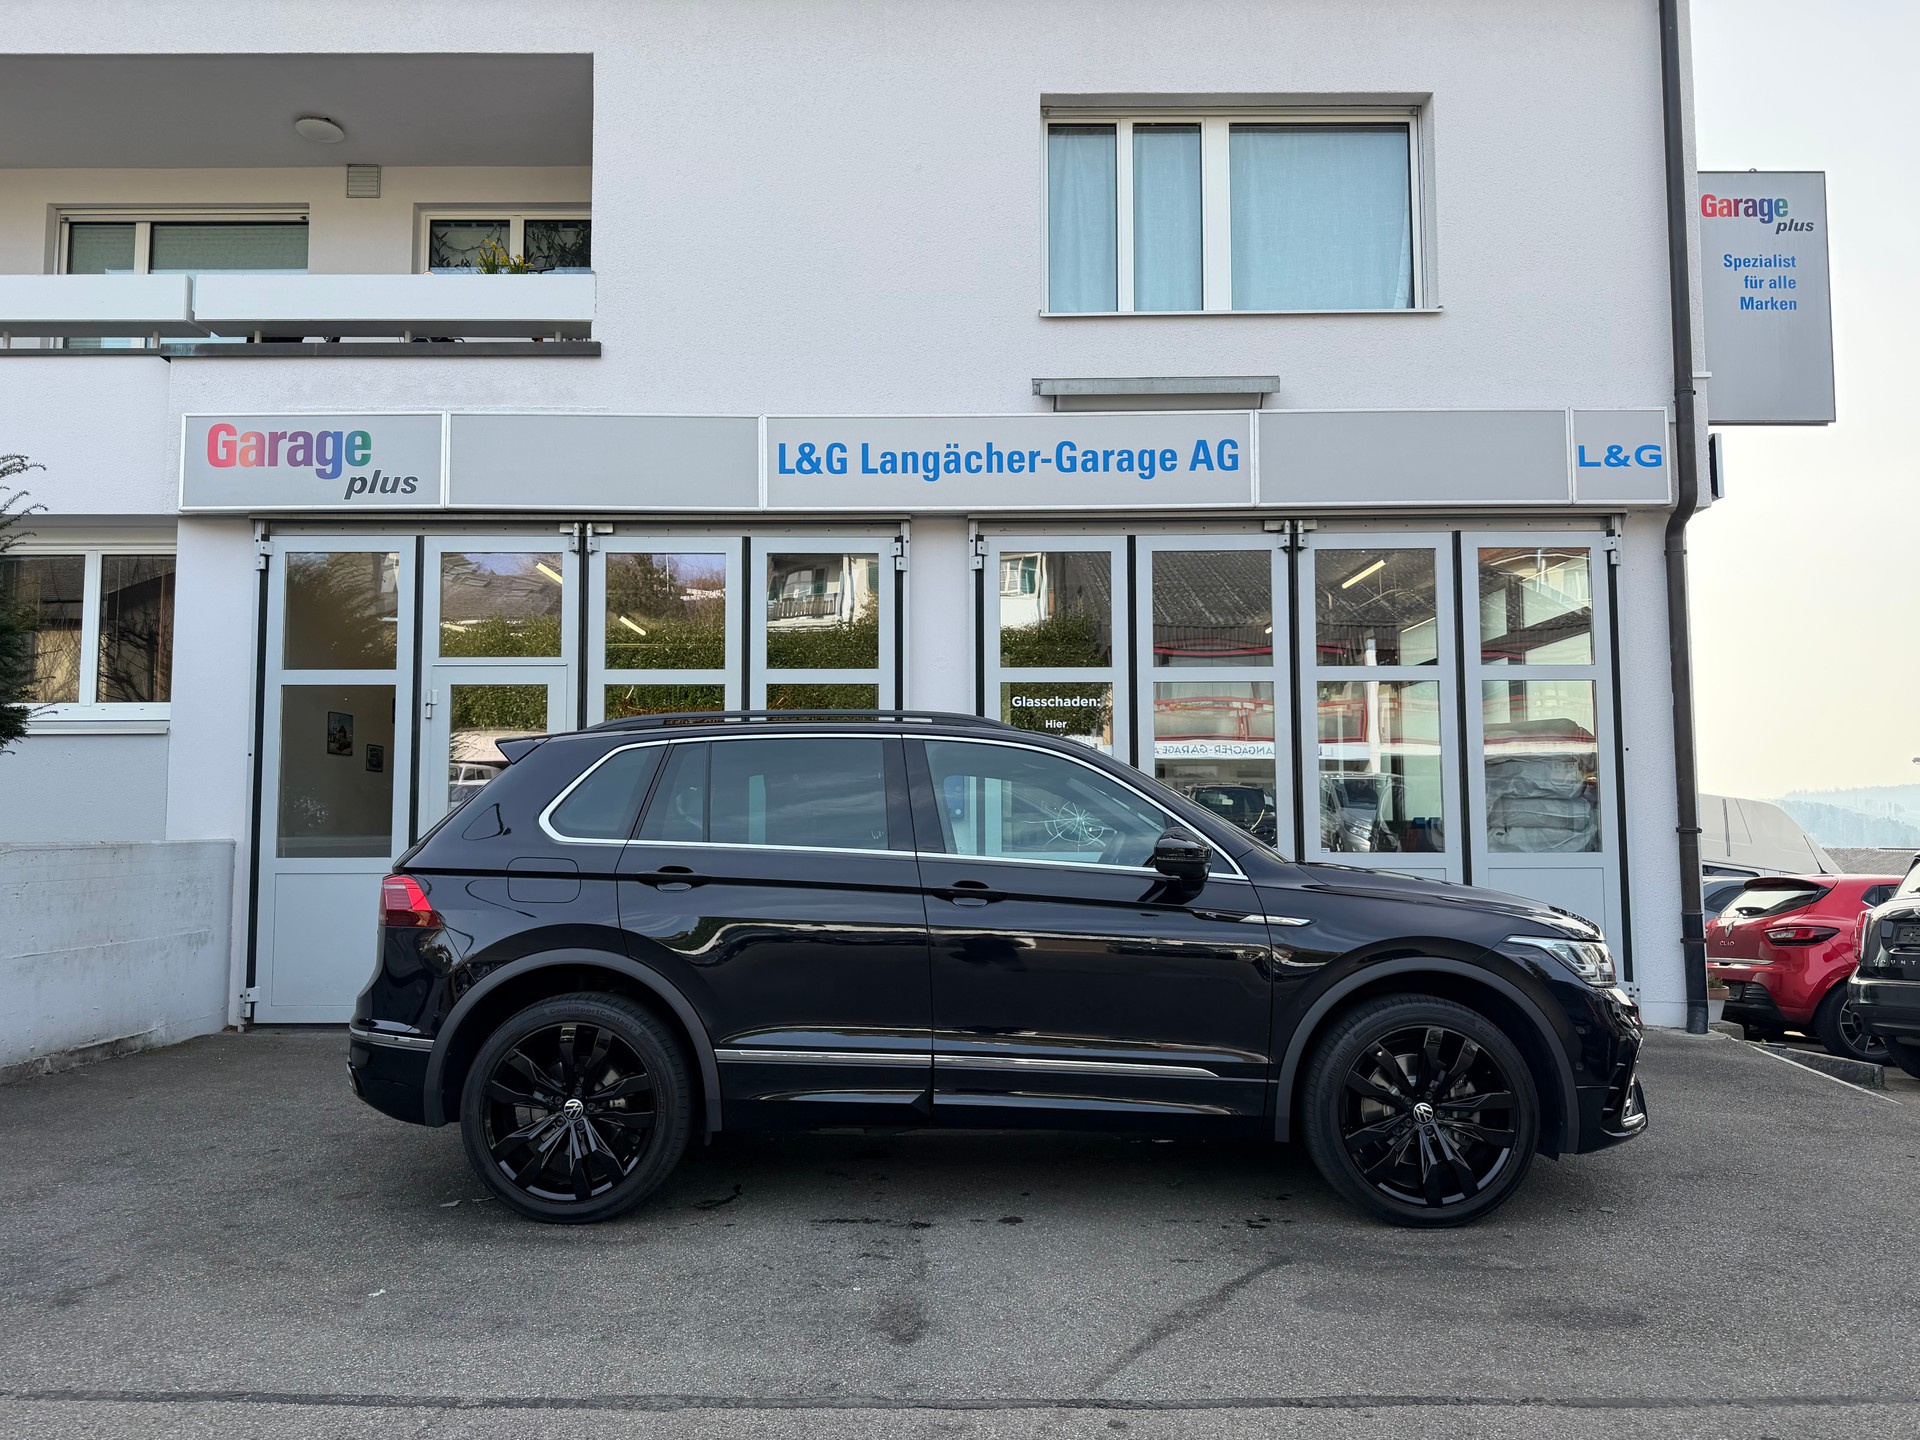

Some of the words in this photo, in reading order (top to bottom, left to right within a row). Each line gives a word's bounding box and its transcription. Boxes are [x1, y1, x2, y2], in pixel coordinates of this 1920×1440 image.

[1701, 194, 1788, 224] Garage
[1776, 219, 1814, 234] plus
[1723, 254, 1796, 271] Spezialist
[1744, 276, 1764, 289] für
[1769, 276, 1796, 289] alle
[1740, 297, 1797, 310] Marken
[207, 423, 372, 479] Garage
[1578, 444, 1662, 467] L&G
[778, 442, 848, 475] L&G
[861, 440, 1177, 482] Langächer-Garage
[1189, 438, 1239, 471] AG
[344, 469, 419, 500] plus
[1012, 696, 1101, 707] Glasschaden:
[1045, 720, 1067, 728] Hier
